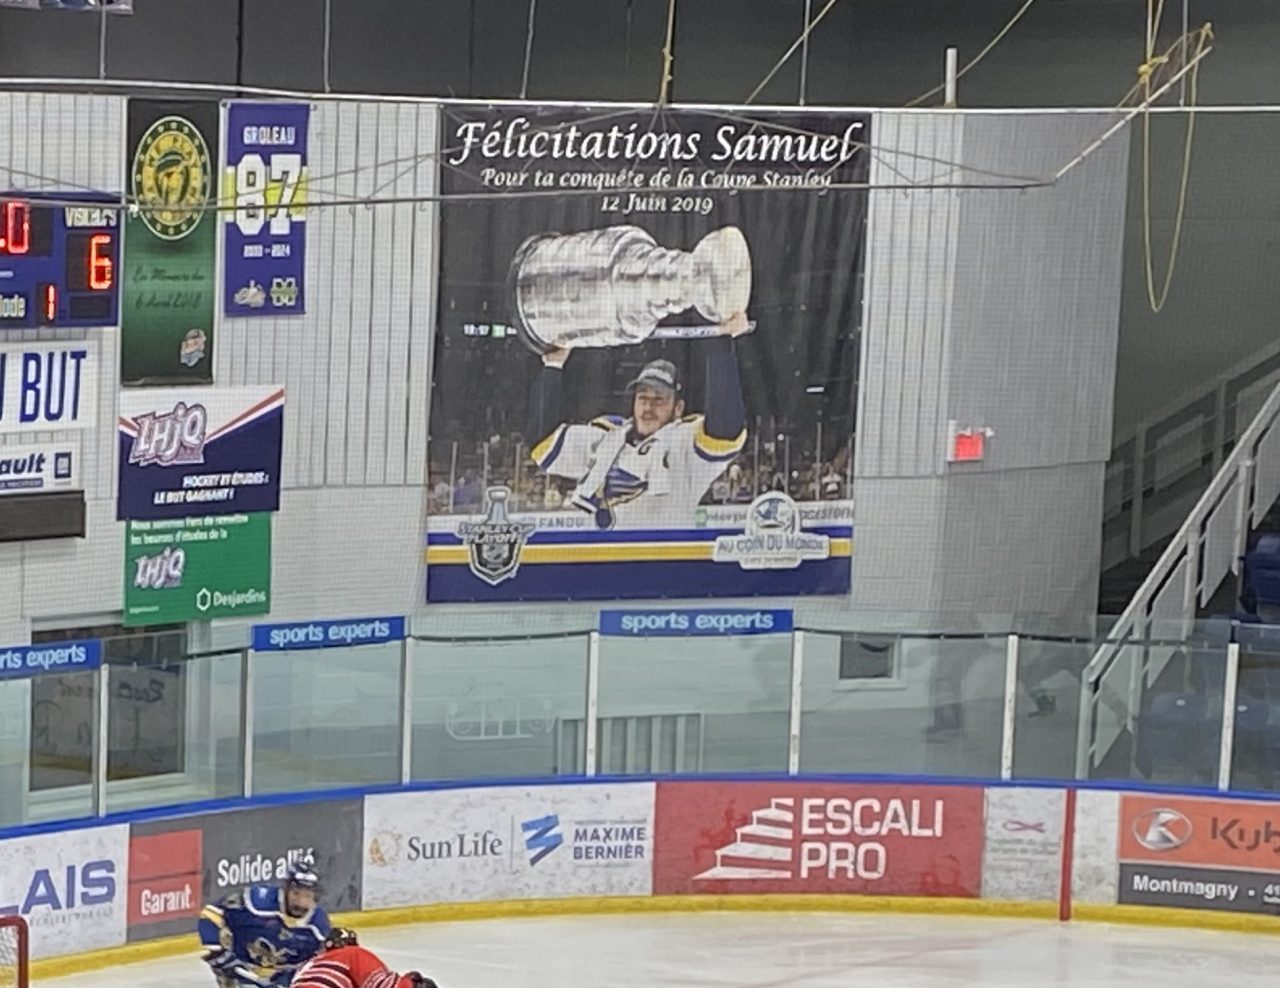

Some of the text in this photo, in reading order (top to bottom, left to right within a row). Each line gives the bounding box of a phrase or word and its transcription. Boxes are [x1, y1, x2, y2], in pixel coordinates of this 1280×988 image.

[243, 126, 296, 145] GROLEAU
[449, 117, 863, 165] Félicitations Samuel
[236, 154, 302, 235] 87
[481, 168, 529, 187] Pour
[534, 170, 554, 187] ta
[650, 167, 671, 187] de
[677, 167, 694, 187] la
[763, 168, 832, 195] Stanley
[601, 194, 713, 215] 12 Juin 2019
[89, 234, 113, 290] 6
[48, 285, 56, 320] 1
[20, 350, 87, 423] BUT
[213, 588, 266, 608] Desjardins
[270, 620, 390, 647] sports experts
[621, 612, 774, 633] sports experts
[26, 644, 86, 670] experts
[801, 797, 943, 837] ESCALI
[407, 830, 503, 861] Sun Life
[574, 826, 646, 843] MAXIME
[573, 844, 645, 860] BERNIER
[800, 841, 886, 879] PRO
[217, 854, 272, 887] Solide
[141, 884, 192, 915] Garant
[1133, 875, 1238, 900] Montmagny
